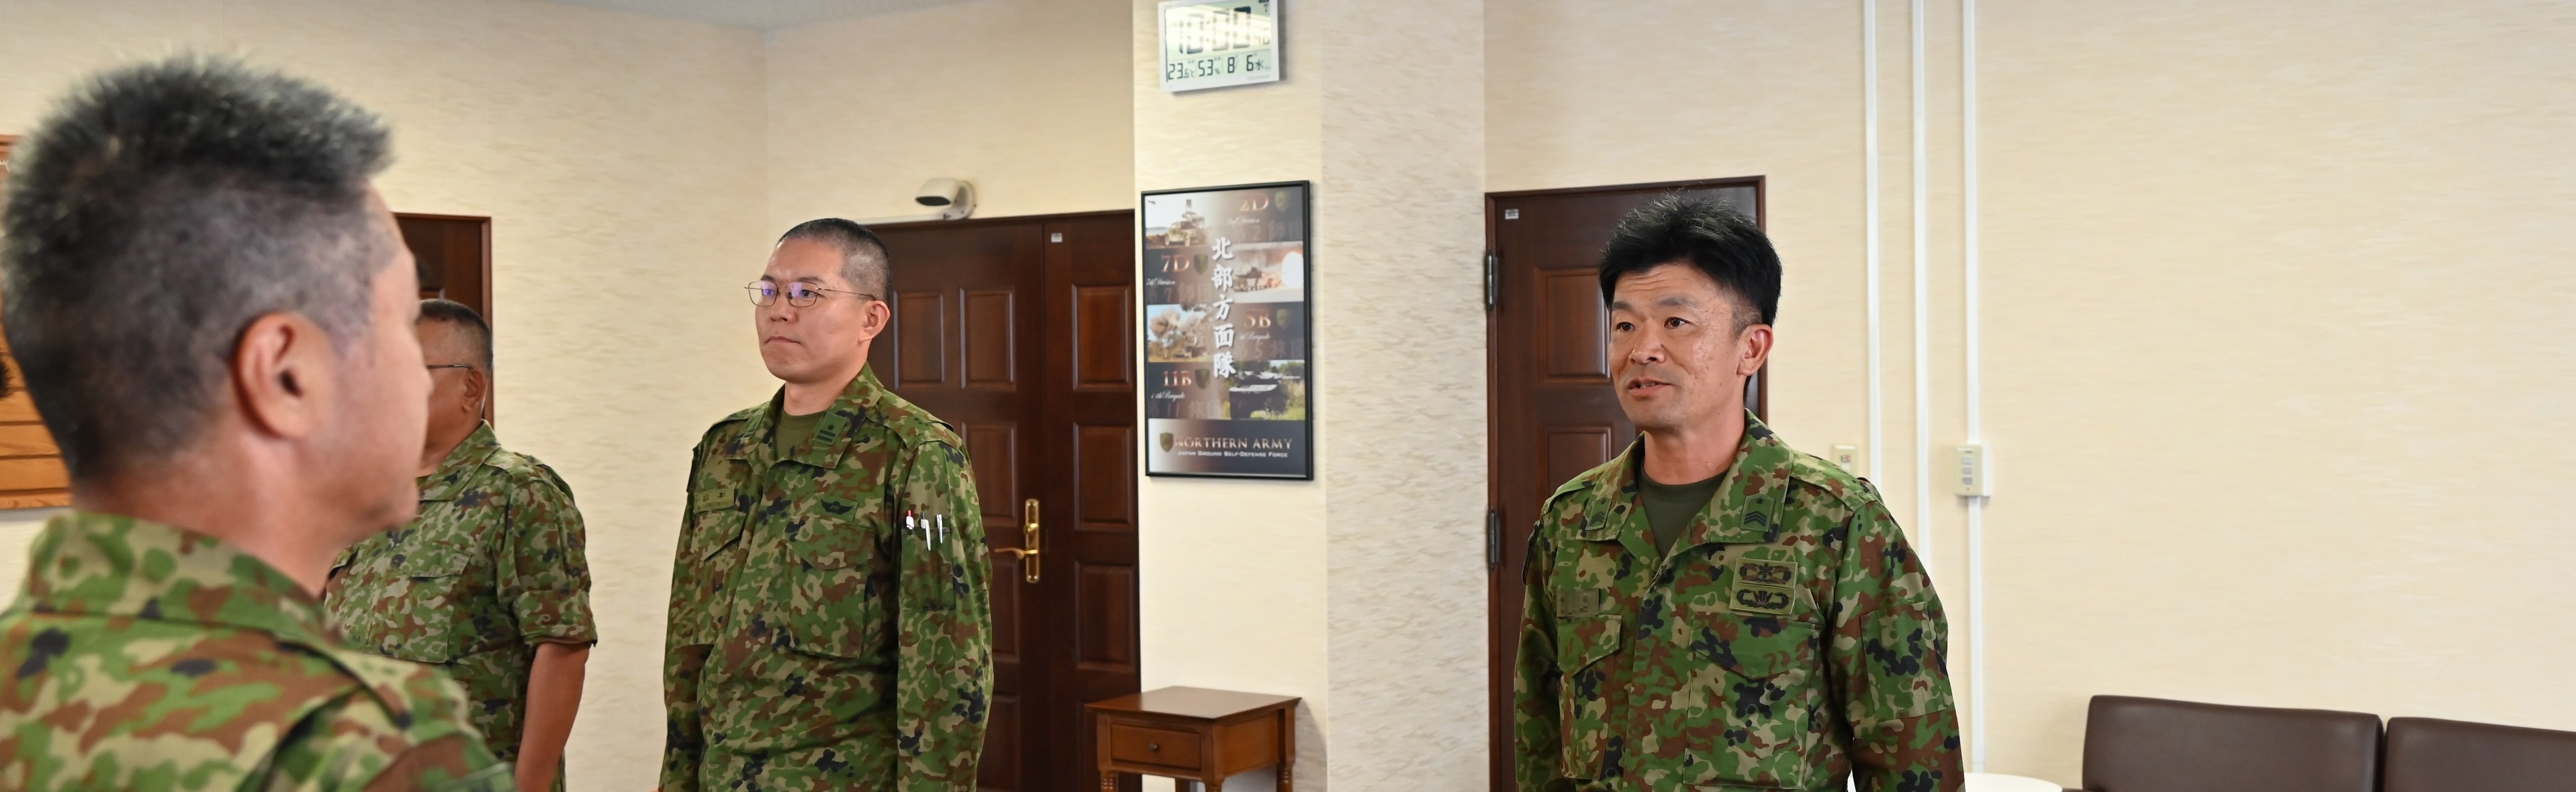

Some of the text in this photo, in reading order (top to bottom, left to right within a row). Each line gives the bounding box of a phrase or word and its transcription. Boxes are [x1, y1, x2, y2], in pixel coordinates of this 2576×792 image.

[1239, 193, 1269, 211] 2D
[1161, 255, 1190, 272] 7D
[1212, 237, 1236, 379] 北部方面隊
[1163, 370, 1192, 387] 11B
[1175, 437, 1292, 449] NORTHERN ARMY
